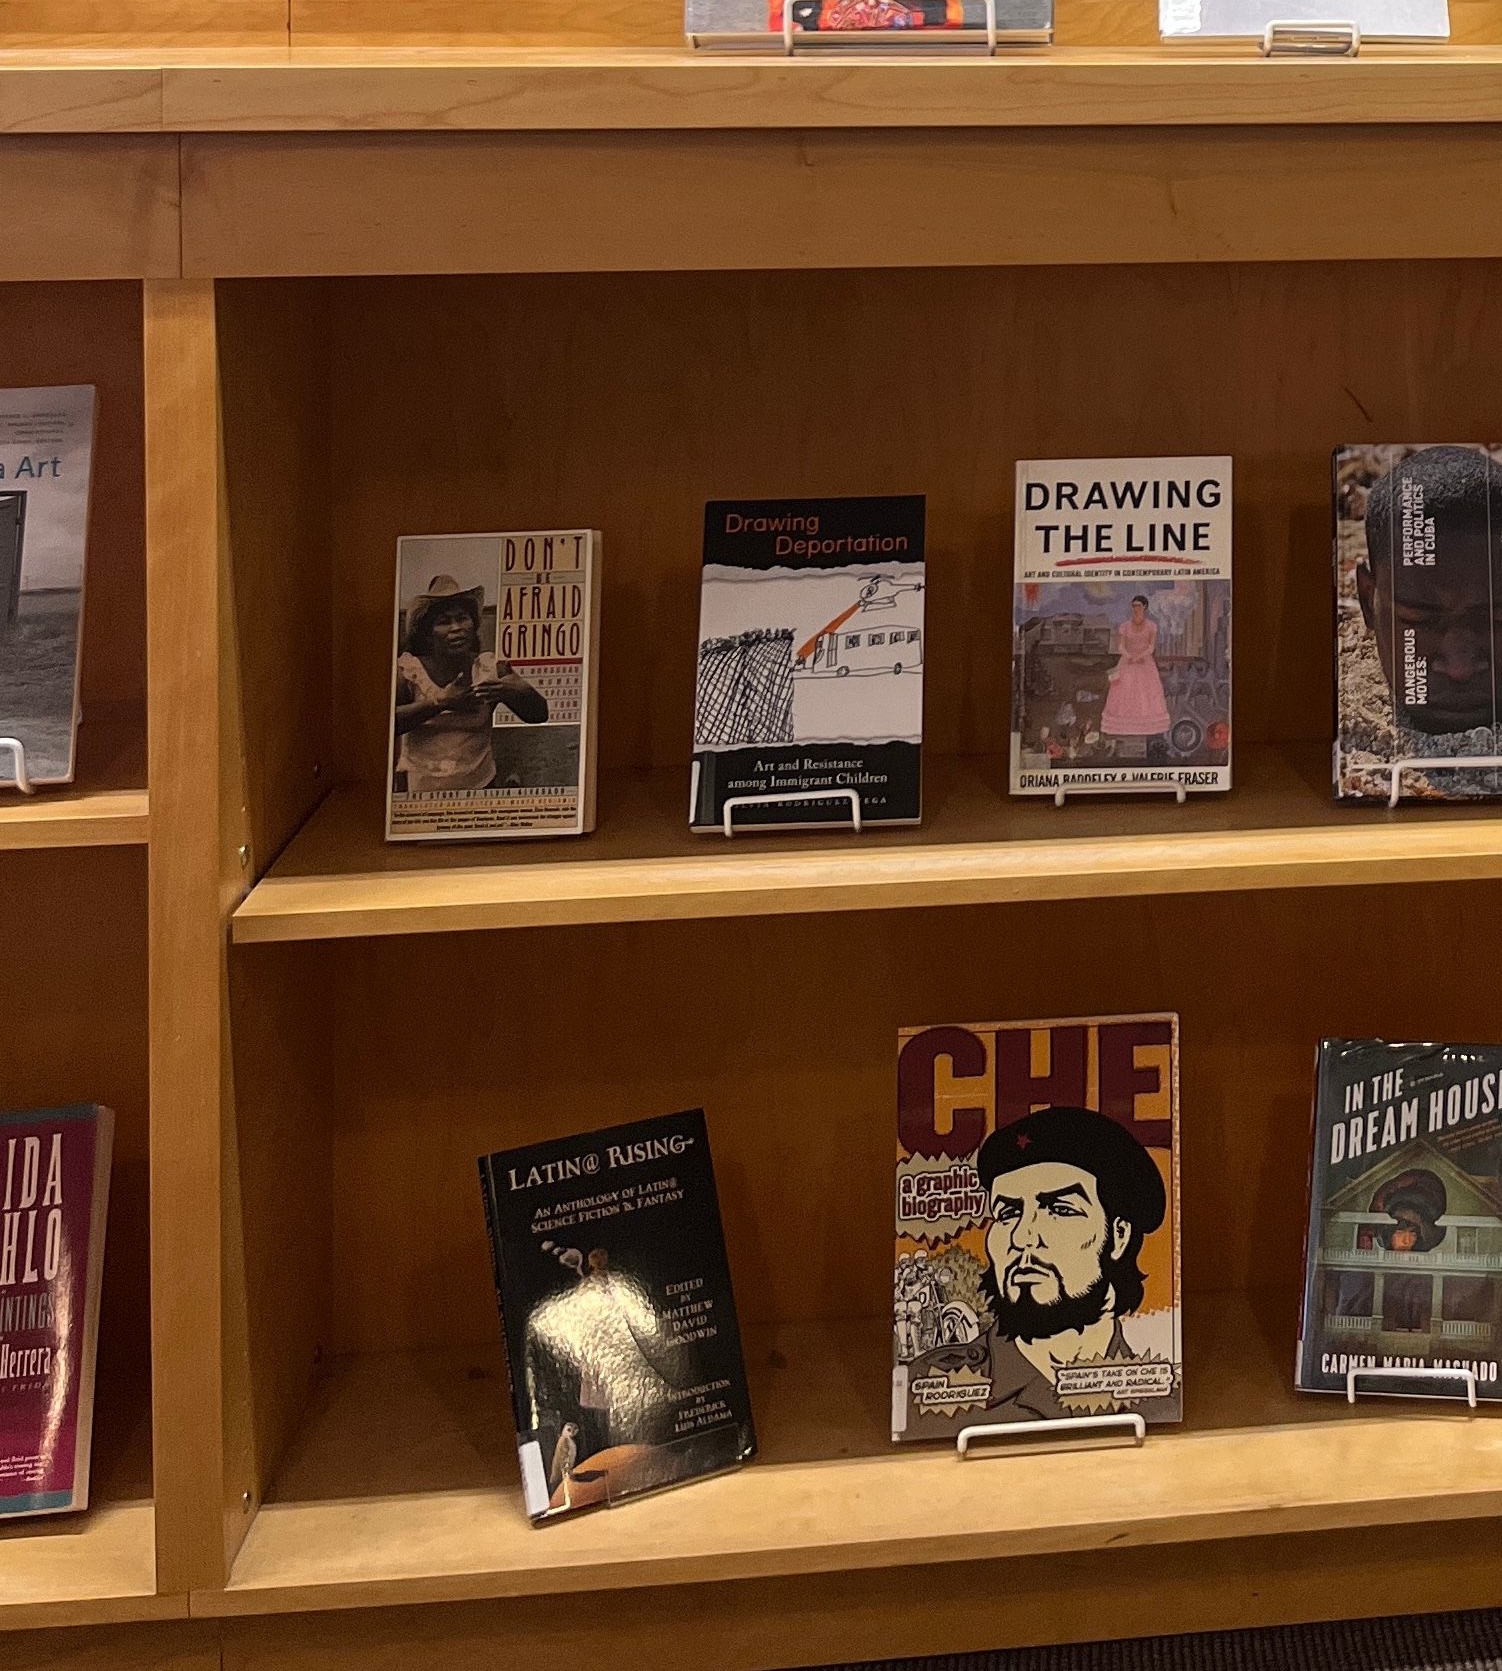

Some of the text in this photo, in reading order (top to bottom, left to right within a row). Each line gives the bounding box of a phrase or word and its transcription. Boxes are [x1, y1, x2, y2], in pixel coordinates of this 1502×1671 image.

[14, 456, 61, 479] Art
[1025, 479, 1221, 511] DRAWING
[726, 513, 820, 535] Drawing
[1035, 522, 1210, 553] THE LINE
[1403, 477, 1413, 566] PERFORMANCE
[1413, 484, 1424, 566] AND POLITICS
[505, 536, 583, 571] DON'T
[776, 534, 908, 559] Deportation
[1425, 517, 1436, 566] IN CUBA
[503, 585, 582, 621] AFRAID
[502, 622, 580, 659] GRINGO
[1405, 629, 1415, 705] DANGEROUS
[1416, 657, 1427, 704] MOVES:
[728, 772, 888, 790] among Immigrant Children
[754, 757, 863, 772] Art and Resistance
[1020, 775, 1060, 788] ORIANA
[900, 1022, 1172, 1157] CHE
[1345, 1080, 1364, 1114] IN
[1373, 1069, 1404, 1100] THE
[1331, 1097, 1418, 1165] DREAM
[4, 1133, 62, 1210] IDA
[508, 1134, 695, 1191] LATIN@ RISING
[637, 1189, 684, 1209] FANTASY
[902, 1166, 978, 1197] a graphic
[901, 1191, 985, 1221] biography
[0, 1209, 62, 1285] HLO
[0, 1344, 51, 1380] Herrera
[914, 1381, 945, 1391] SPAIN
